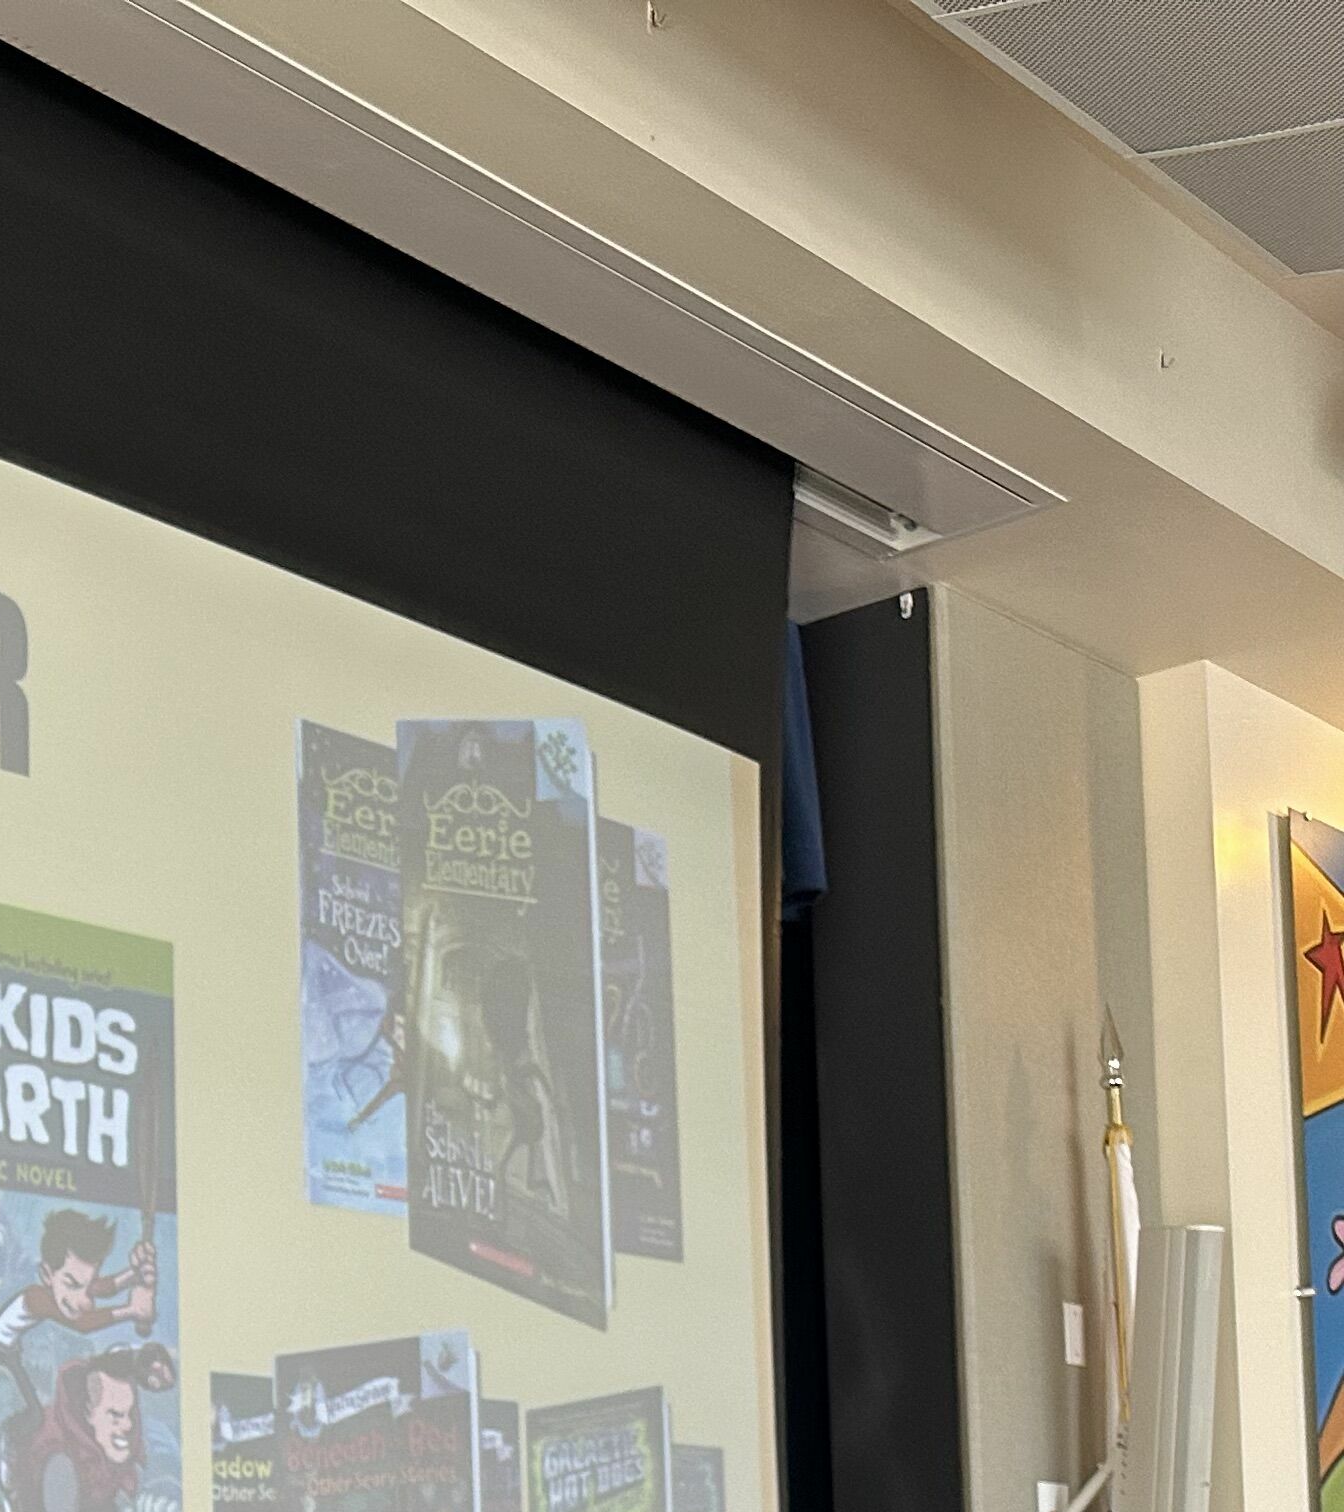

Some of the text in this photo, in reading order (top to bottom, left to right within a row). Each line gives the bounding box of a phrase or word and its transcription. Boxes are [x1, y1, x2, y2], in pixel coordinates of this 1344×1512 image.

[325, 786, 398, 837] Eer
[428, 812, 534, 860] Eerie
[424, 850, 536, 900] Elementary
[318, 887, 402, 948] FREEZES
[15, 1164, 78, 1192] NOVEL
[211, 1455, 273, 1480] adow
